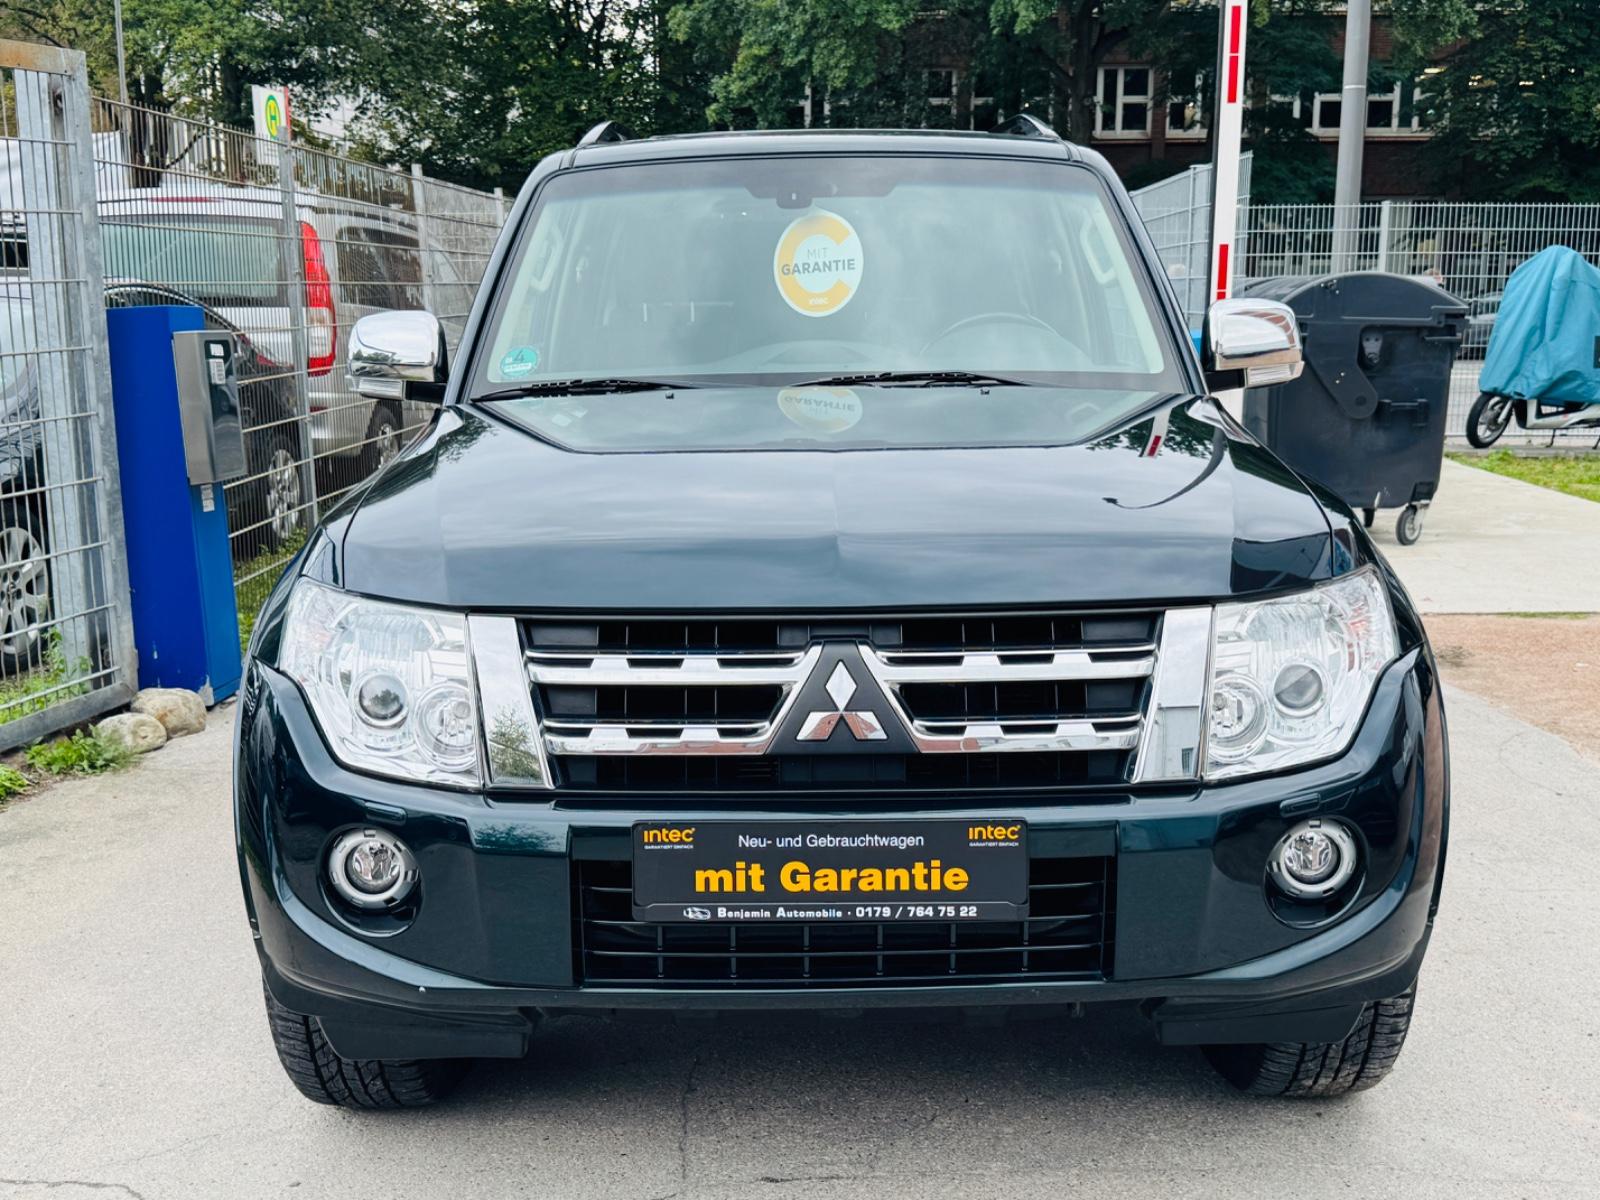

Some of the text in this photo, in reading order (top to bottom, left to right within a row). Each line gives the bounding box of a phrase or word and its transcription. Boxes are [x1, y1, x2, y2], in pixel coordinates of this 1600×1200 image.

[807, 247, 829, 260] MIT
[781, 259, 856, 276] GARANTIE
[643, 827, 696, 843] intec
[968, 825, 1021, 840] intec
[738, 834, 925, 850] Neu- und Gebrauchtwagen
[695, 859, 969, 893] mit Garantie
[717, 907, 771, 919] Benjamin
[776, 907, 843, 918] Automobile
[855, 906, 891, 918] 0179
[907, 906, 934, 917] 764
[937, 906, 955, 917] 75
[959, 905, 978, 917] 22
